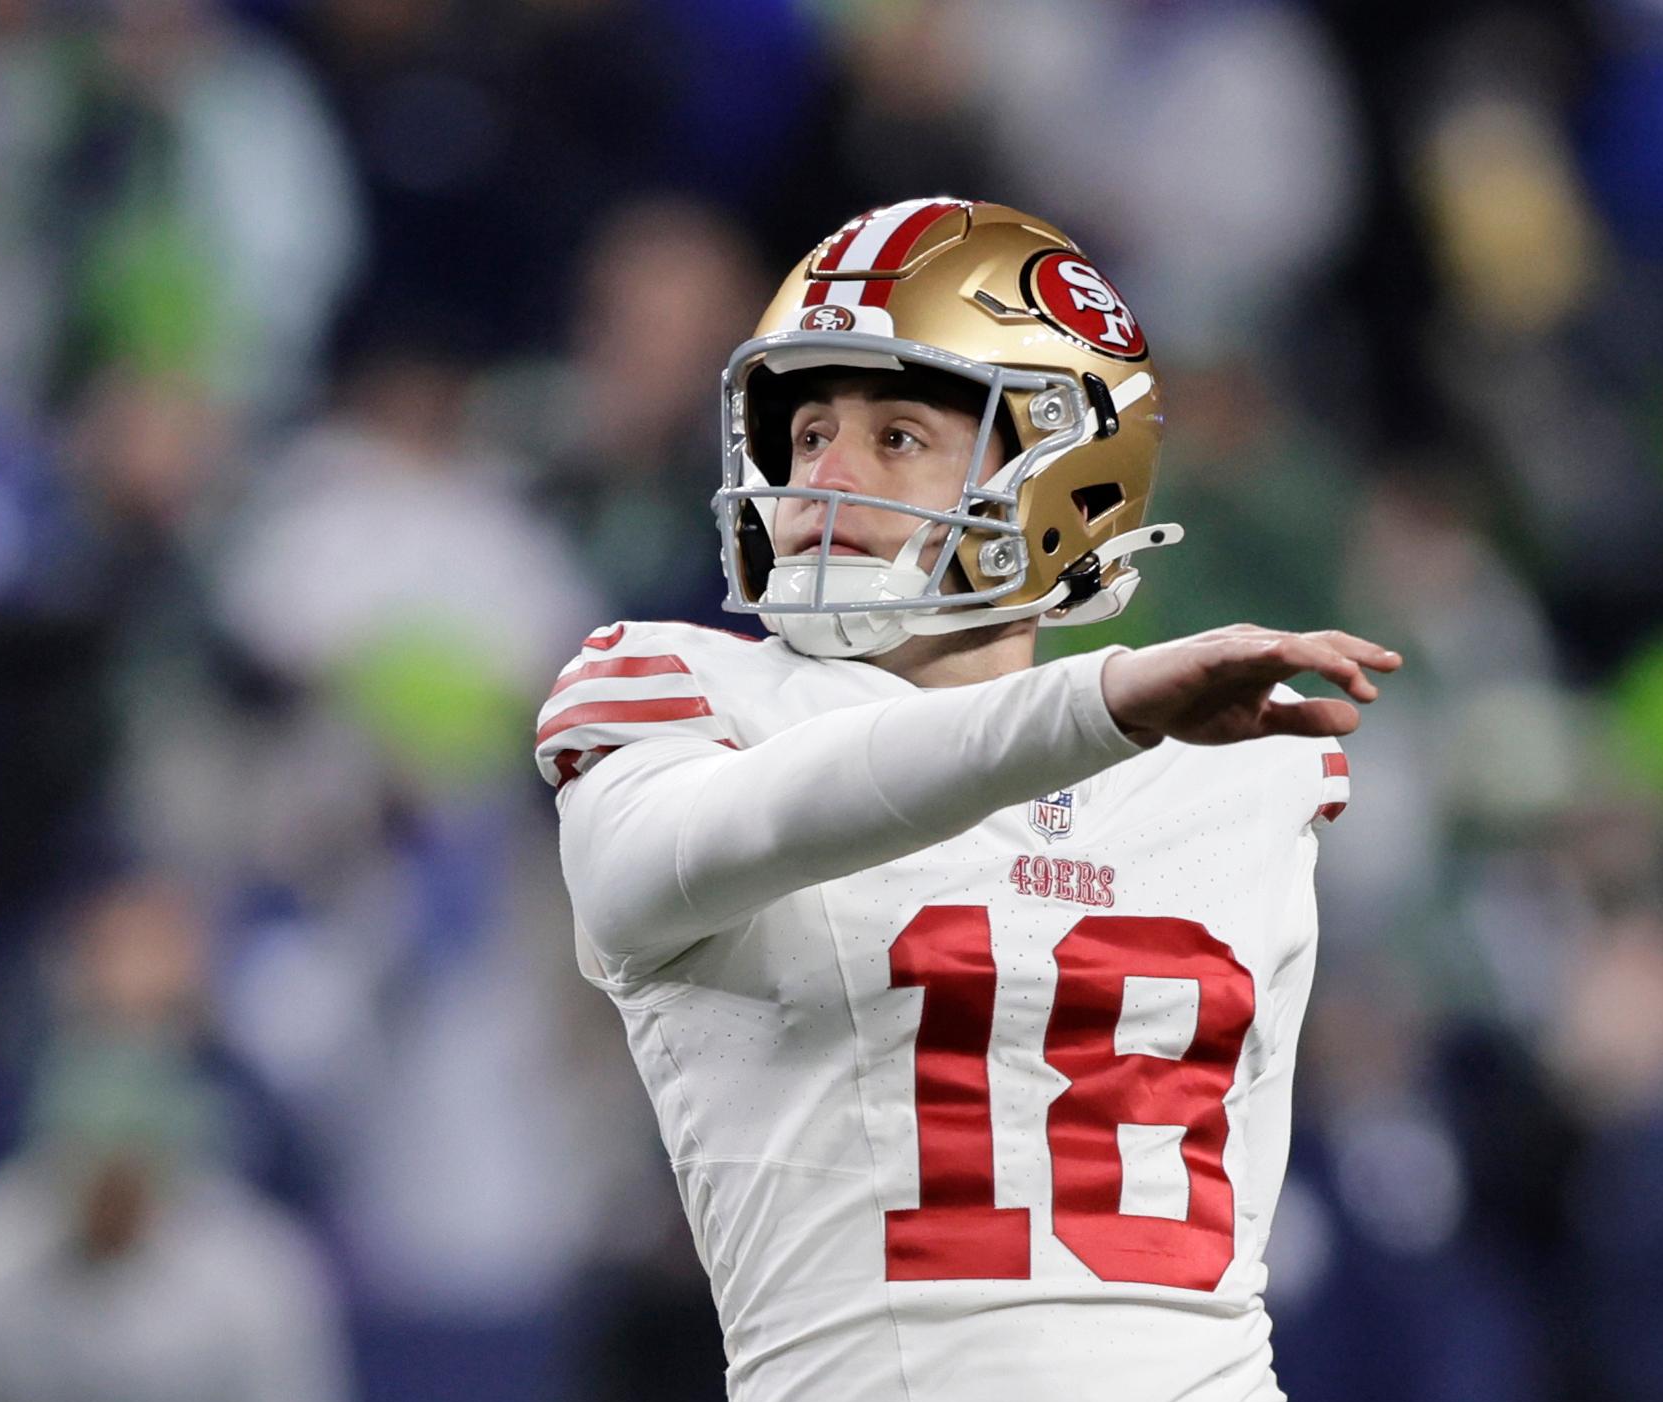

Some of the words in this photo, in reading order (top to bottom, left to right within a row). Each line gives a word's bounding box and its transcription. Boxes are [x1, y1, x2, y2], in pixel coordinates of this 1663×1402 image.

[1037, 804, 1068, 830] NFL
[1009, 855, 1115, 908] 49ERS
[884, 905, 1256, 1292] 18
